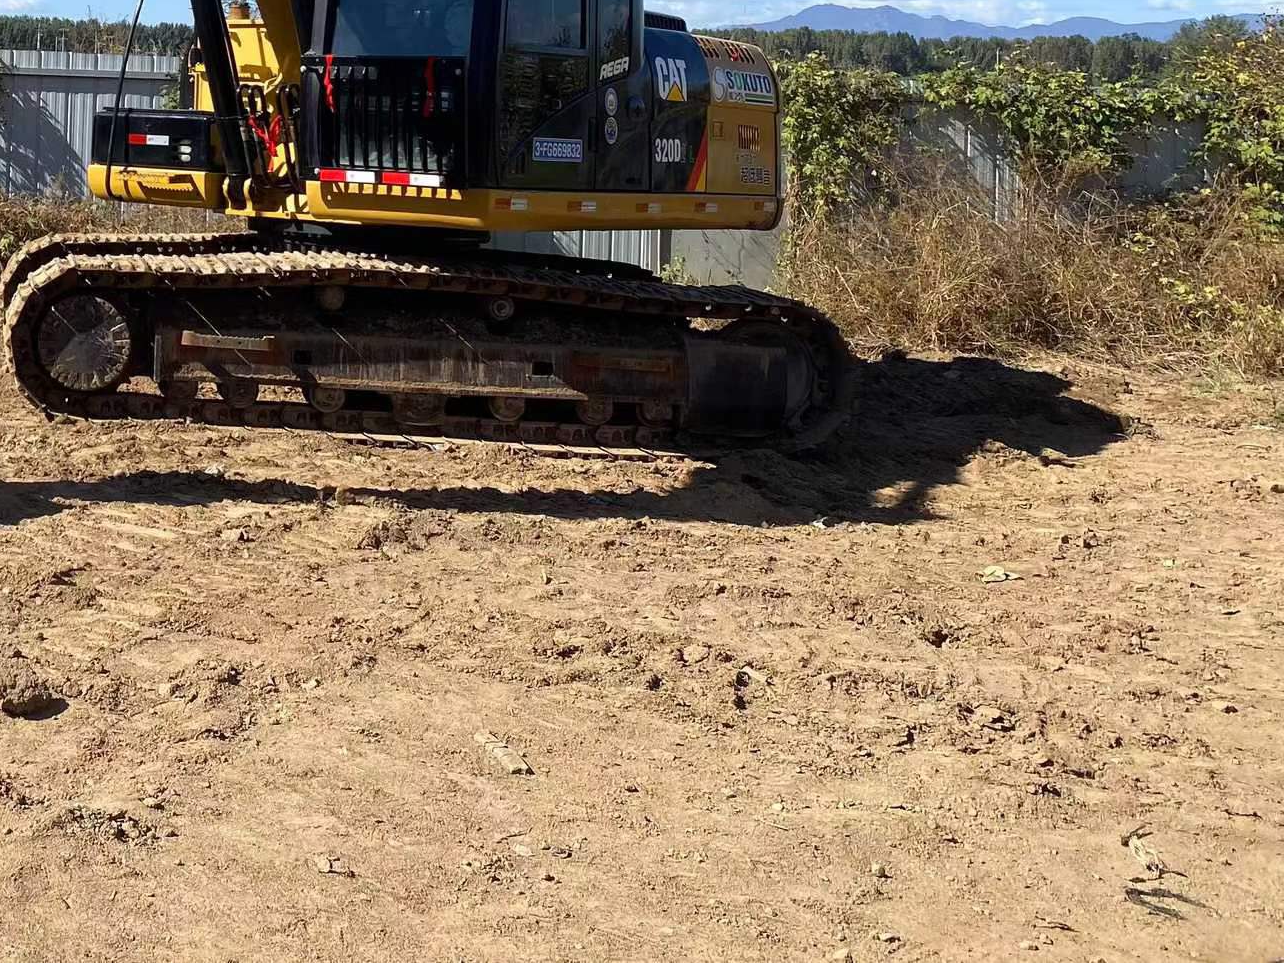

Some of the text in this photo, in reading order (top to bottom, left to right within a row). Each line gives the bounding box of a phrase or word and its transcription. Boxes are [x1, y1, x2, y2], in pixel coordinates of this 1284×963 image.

[654, 56, 688, 102] CAT
[726, 70, 772, 94] SOKUTO
[654, 137, 681, 163] 320D
